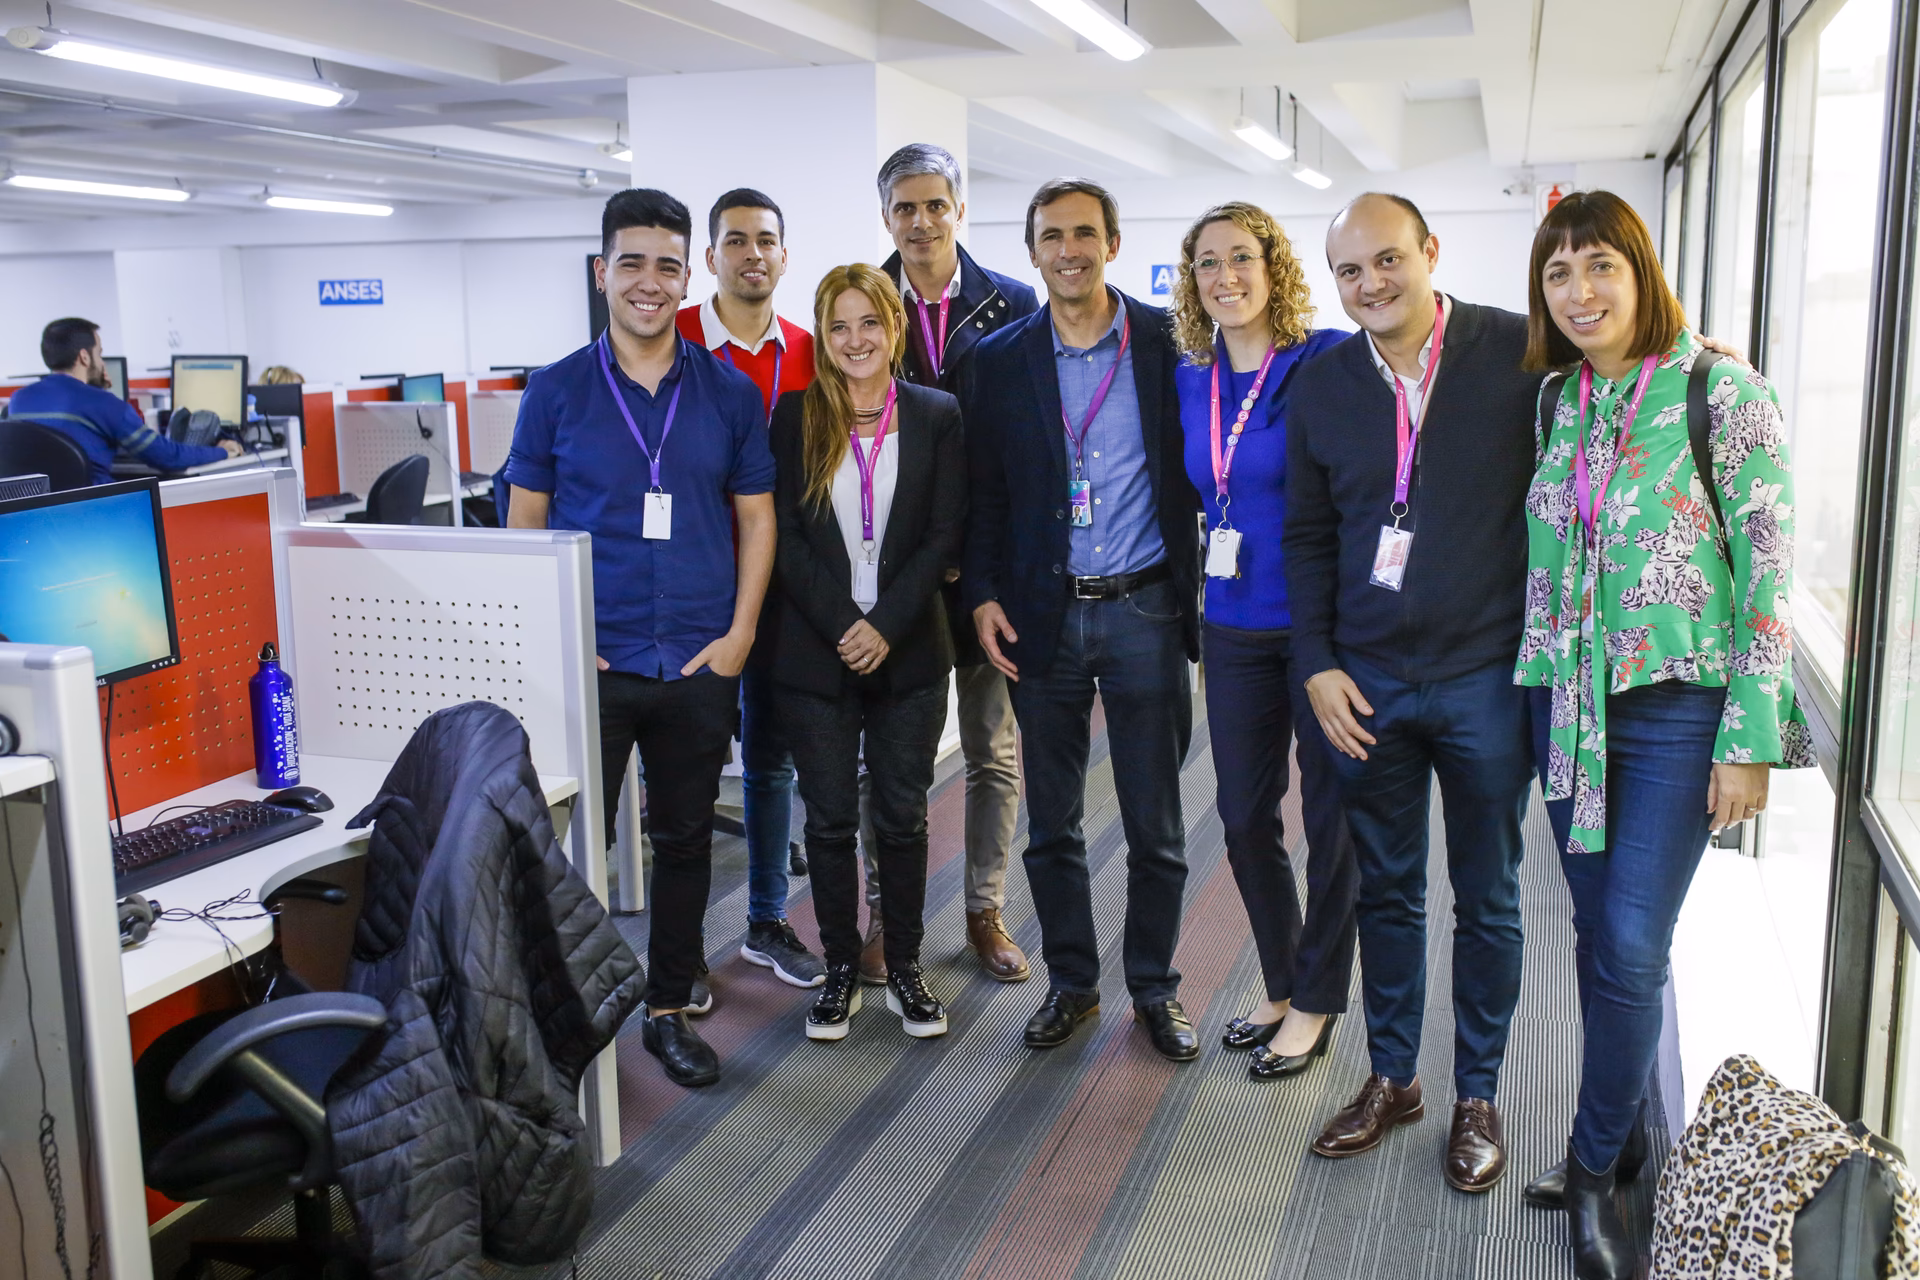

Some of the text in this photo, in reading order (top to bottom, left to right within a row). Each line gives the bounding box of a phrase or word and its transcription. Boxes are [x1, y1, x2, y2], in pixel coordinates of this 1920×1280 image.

[321, 281, 382, 301] ANSES
[1634, 369, 1650, 404] Teleperformance
[281, 695, 296, 768] HIDRATACION VIDA SANA
